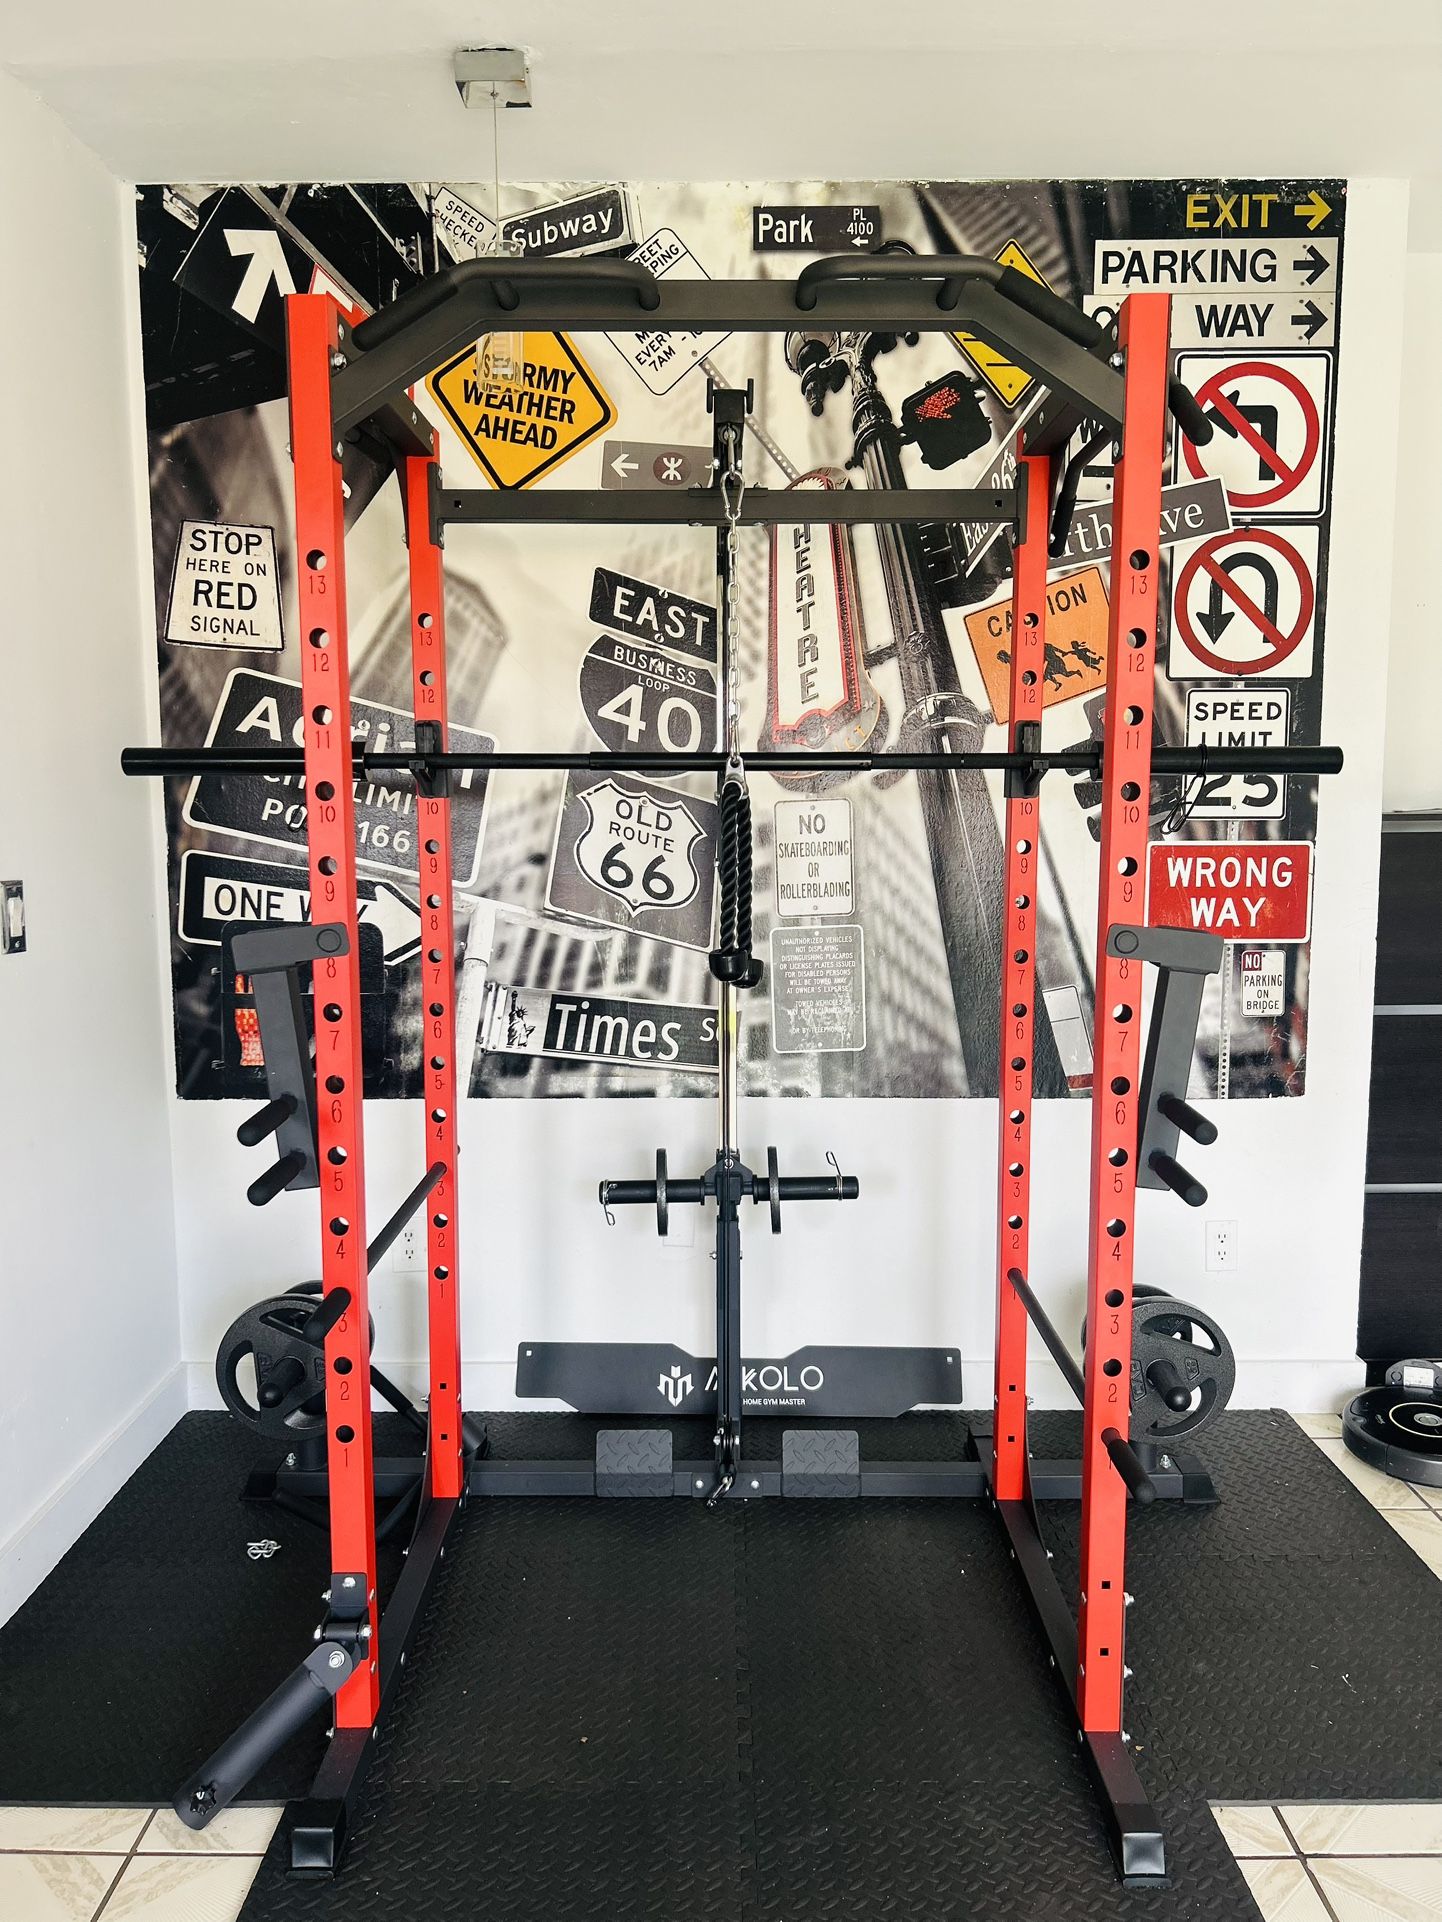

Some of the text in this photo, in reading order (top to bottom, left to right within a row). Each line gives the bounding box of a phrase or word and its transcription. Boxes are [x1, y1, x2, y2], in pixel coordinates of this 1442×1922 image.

[445, 200, 485, 233] SPEED
[853, 208, 867, 220] PL
[1186, 194, 1278, 228] EXIT
[435, 209, 477, 249] HECKE
[511, 208, 613, 252] Subway
[758, 213, 814, 243] Park
[846, 222, 874, 235] 4100
[1101, 248, 1277, 285] PARKING
[1195, 304, 1274, 338] WAY
[635, 332, 673, 365] EVERY
[649, 346, 676, 372] 7AM
[463, 379, 576, 425] WEATHER
[474, 413, 558, 451] AHEAD
[190, 529, 263, 556] STOP
[186, 557, 267, 577] HERE ON
[193, 579, 257, 611] RED
[309, 575, 327, 595] 13
[1131, 575, 1148, 595] 13
[613, 586, 710, 647] EAST
[793, 524, 820, 704] HEATRE
[190, 615, 261, 636] SIGNAL
[419, 631, 433, 646] 13
[1025, 632, 1037, 646] 13
[311, 652, 330, 672] 12
[1128, 653, 1145, 672] 12
[638, 675, 670, 693] LOOP
[421, 689, 435, 704] 12
[1023, 688, 1036, 704] 12
[597, 683, 702, 752] 40
[1194, 702, 1282, 721] SPEED
[315, 730, 331, 749] 11
[1126, 731, 1140, 750] 11
[353, 782, 418, 815] LIMI
[1194, 774, 1279, 807] 25
[319, 804, 336, 824] 10
[425, 801, 440, 816] 10
[616, 799, 672, 832] OLD
[1020, 802, 1033, 816] 10
[1123, 805, 1140, 825] 10
[799, 813, 826, 835] NO
[609, 821, 675, 853] ROUTE
[779, 840, 849, 859] SKATEBOARDING
[430, 857, 438, 874] 9
[600, 842, 675, 901] 66
[808, 862, 820, 878] OR
[1020, 858, 1029, 874] 9
[1166, 856, 1293, 888] WRONG
[325, 880, 335, 902] 9
[780, 881, 850, 900] ROLLERBLADING
[1123, 881, 1133, 903] 9
[214, 883, 285, 921] ONE
[430, 914, 439, 931] 8
[1190, 897, 1267, 928] WAY
[1018, 915, 1026, 931] 8
[826, 936, 853, 944] VEHICLES
[327, 957, 337, 979] 8
[789, 962, 812, 970] LICENSE
[814, 961, 834, 969] PLATES
[1119, 958, 1129, 981] 8
[1245, 954, 1261, 968] NO
[432, 969, 440, 985] 7
[1017, 970, 1025, 985] 7
[1244, 974, 1283, 987] PARKING
[1257, 989, 1269, 999] ON
[1247, 1000, 1280, 1010] BRIDGE
[330, 1030, 340, 1051] 7
[433, 1022, 442, 1039] 6
[555, 1001, 682, 1061] Times
[1016, 1022, 1024, 1040] 6
[1118, 1031, 1128, 1053] 7
[435, 1074, 443, 1090] 5
[1015, 1075, 1023, 1091] 5
[332, 1100, 342, 1124] 6
[1115, 1101, 1126, 1125] 6
[436, 1126, 443, 1141] 4
[1014, 1127, 1022, 1142] 4
[334, 1171, 343, 1192] 5
[1013, 1182, 1021, 1198] 3
[1114, 1172, 1123, 1193] 5
[336, 1239, 345, 1259] 4
[438, 1232, 446, 1248] 2
[1012, 1233, 1020, 1250] 2
[1112, 1241, 1121, 1261] 4
[1111, 1314, 1120, 1335] 3
[704, 1365, 825, 1391] KOLO
[340, 1381, 350, 1401] 2
[1108, 1383, 1118, 1403] 2
[743, 1398, 806, 1406] HOME GYM MASTER
[344, 1447, 349, 1468] 1
